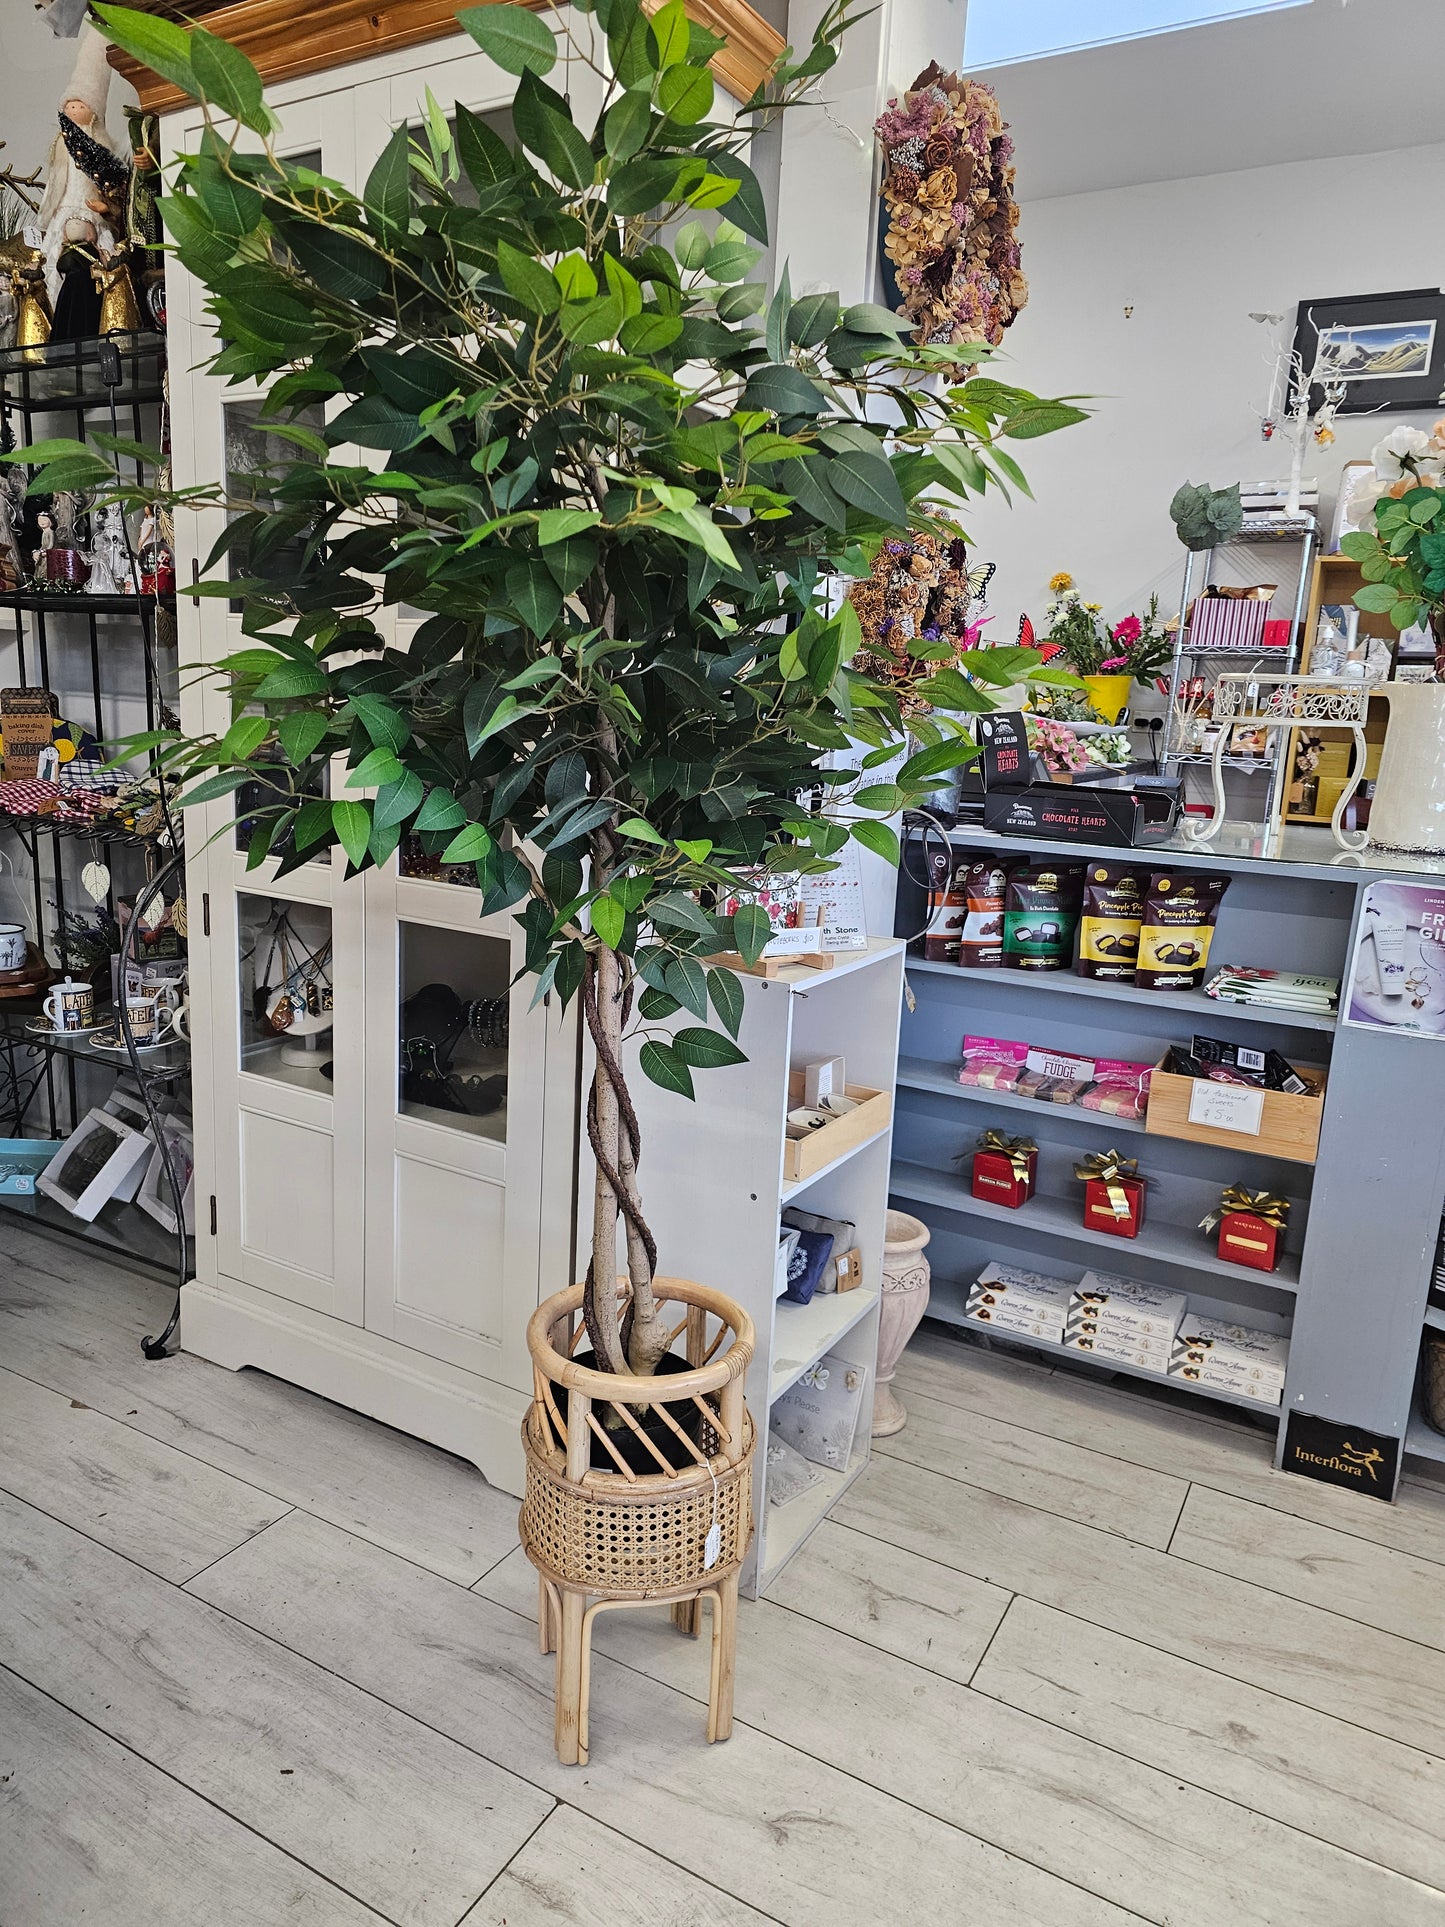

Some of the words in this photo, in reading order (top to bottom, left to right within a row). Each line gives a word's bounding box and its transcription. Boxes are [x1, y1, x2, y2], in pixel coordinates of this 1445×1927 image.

[997, 758, 1019, 772] HEARTS
[876, 775, 883, 784] in
[1017, 819, 1037, 827] ZEALAND
[1041, 812, 1080, 825] CHOCOLATE
[1081, 816, 1107, 827] HEARTS
[1098, 900, 1130, 912] Pineapple
[1157, 908, 1188, 920] Pineapple
[1188, 908, 1206, 918] Pieces
[835, 926, 859, 935] Stone
[1292, 977, 1329, 987] you
[1043, 1061, 1077, 1080] FUDGE
[996, 1275, 1030, 1291] Queen
[1026, 1285, 1059, 1295] Anne
[1095, 1286, 1130, 1299] Queen
[1127, 1295, 1162, 1306] Anne
[1000, 1297, 1018, 1310] Queen
[1016, 1302, 1035, 1314] Anne
[995, 1312, 1014, 1325] Queen
[1012, 1317, 1031, 1329] Anne
[1101, 1310, 1121, 1322] Queen
[1120, 1315, 1139, 1326] Anne
[1100, 1326, 1120, 1338] Queen
[1119, 1332, 1137, 1343] Anne
[1199, 1330, 1236, 1343] Queen
[1233, 1340, 1270, 1352] Anne
[1096, 1341, 1116, 1353] Queen
[1115, 1347, 1134, 1358] Anne
[1207, 1355, 1228, 1368] Queen
[1227, 1361, 1248, 1373] Anne
[1203, 1371, 1224, 1384] Queen
[1222, 1376, 1243, 1389] Anne
[794, 1395, 821, 1414] Please
[1295, 1446, 1362, 1477] Interflora
